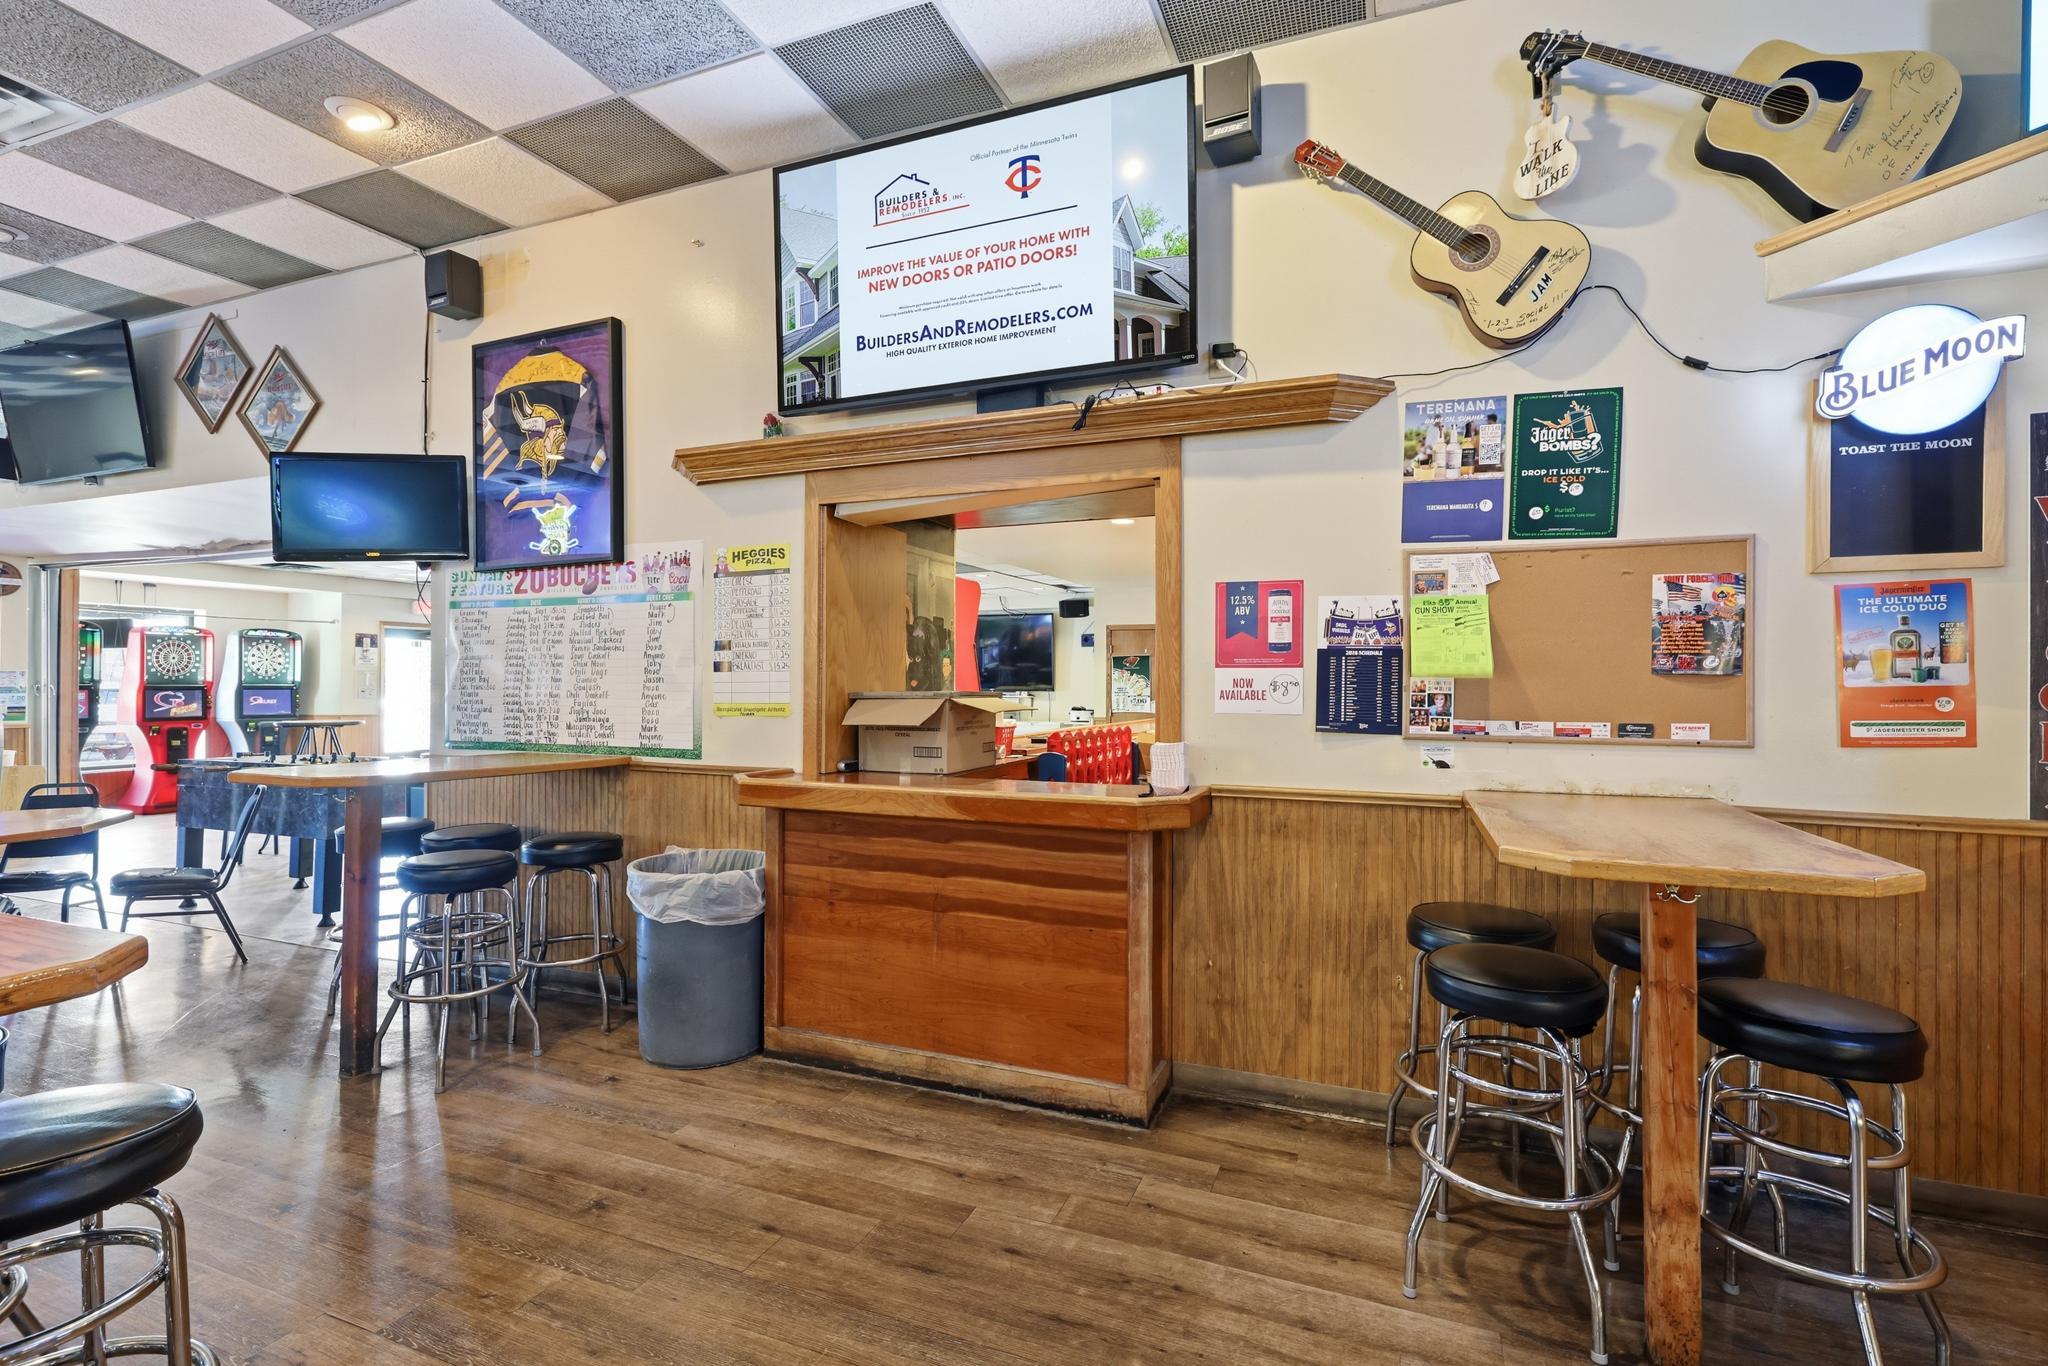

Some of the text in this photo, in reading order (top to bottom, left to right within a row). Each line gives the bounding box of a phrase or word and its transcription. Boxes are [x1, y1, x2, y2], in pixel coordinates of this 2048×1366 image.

[1208, 121, 1247, 137] BOSE
[1030, 137, 1061, 148] Minnesota
[1520, 139, 1564, 178] WALK
[1536, 166, 1553, 179] the
[1536, 164, 1569, 197] LINE
[880, 188, 939, 208] BUILDERS &
[857, 226, 1090, 279] IMPROVE THE VALUE OF YOUR HOME WITH
[869, 245, 1078, 293] NEW DOORS OR PATIO DOORS!
[1532, 273, 1553, 302] JAM
[886, 326, 1057, 358] HIGH QUALITY EXTERIOR HOME IMPROVEMENT
[1825, 323, 2018, 412] BLUE MOON
[1416, 400, 1496, 415] TEREMANA
[1530, 426, 1570, 444] Jäger
[1540, 432, 1602, 453] BOMBS?
[1839, 438, 1974, 456] TOAST THE MOON
[1522, 469, 1547, 477] DROP
[1543, 476, 1558, 484] ICE
[1560, 481, 1569, 494] $
[732, 548, 786, 564] HEGGIES
[746, 558, 772, 567] PIZZA
[450, 583, 513, 597] FEATURE
[1231, 596, 1256, 605] 12.5%
[1858, 595, 1948, 606] THE ULTIMATE
[1235, 606, 1251, 616] ABV
[1432, 606, 1455, 614] SHOW
[1860, 603, 1947, 614] ICE COLD DUO
[1232, 678, 1254, 689] NOW
[1219, 690, 1268, 701] AVAILABLE
